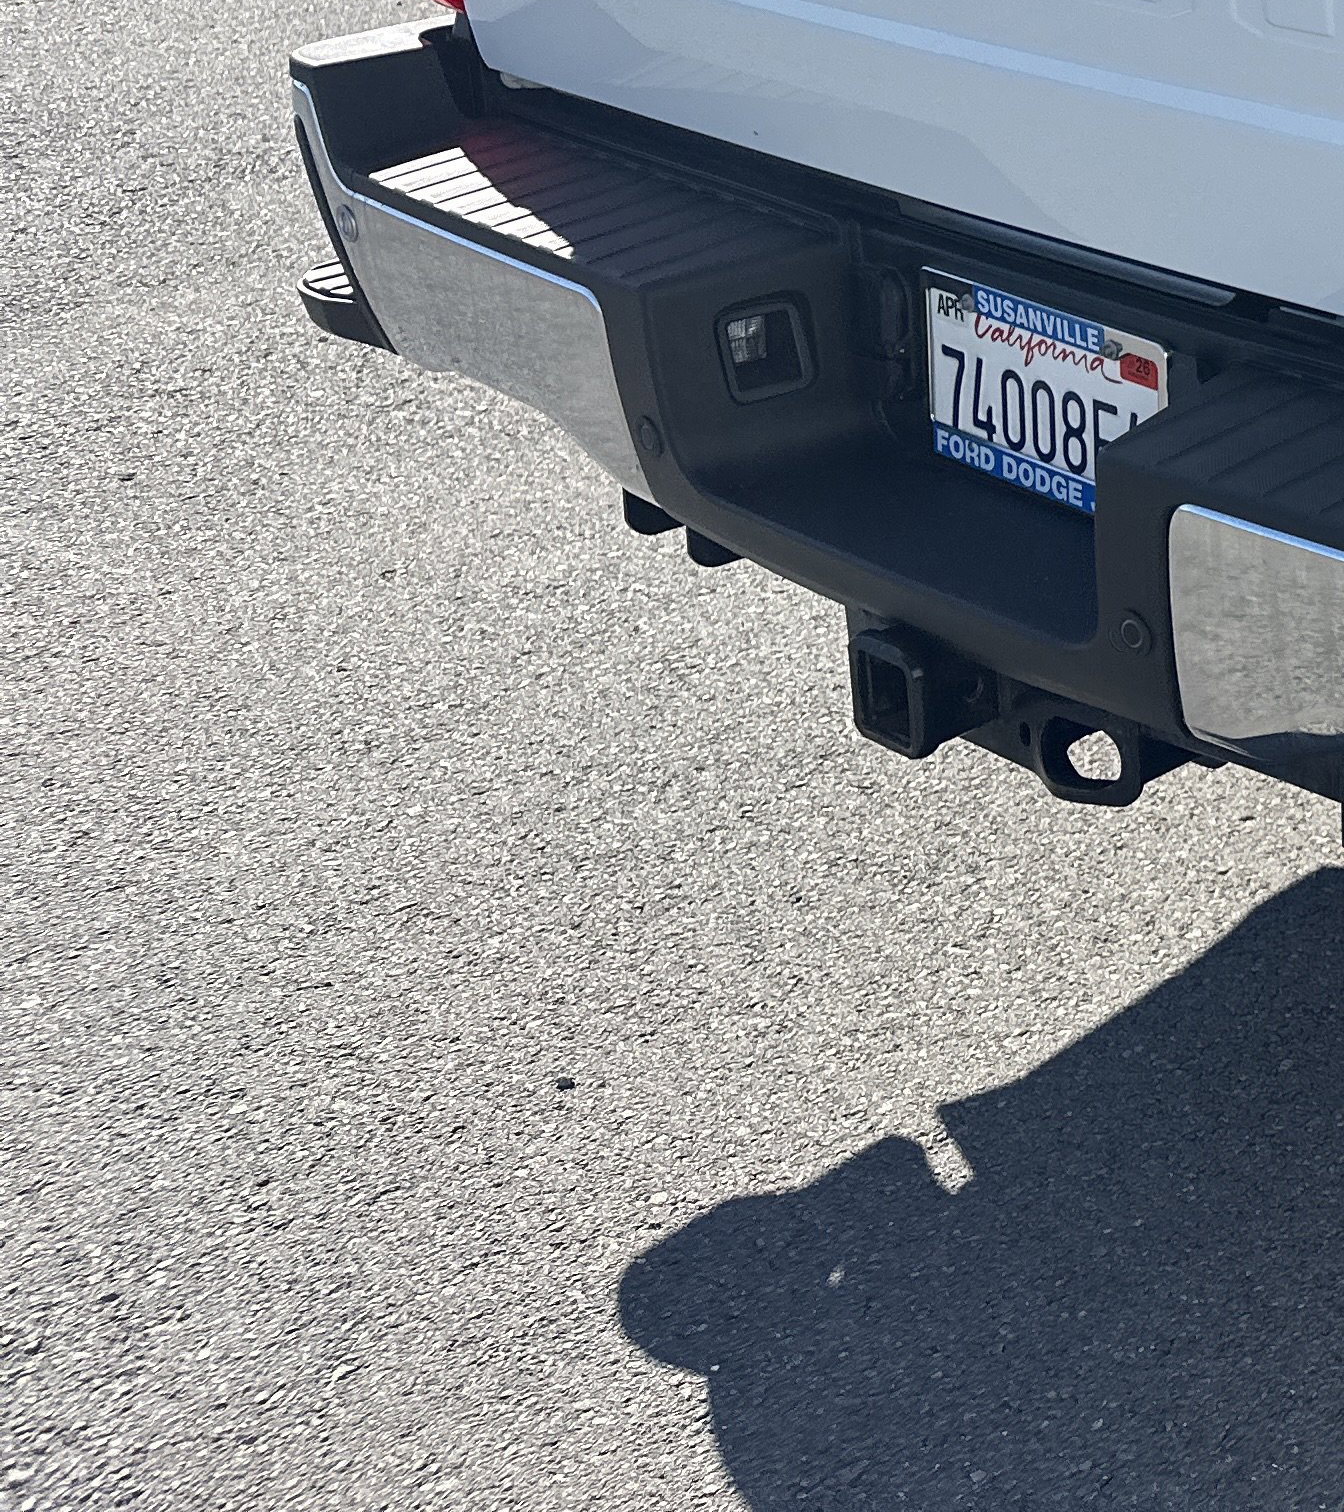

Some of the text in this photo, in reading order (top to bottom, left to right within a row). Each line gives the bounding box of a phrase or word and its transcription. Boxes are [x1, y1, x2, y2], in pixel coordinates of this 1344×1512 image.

[936, 293, 966, 324] APR
[975, 290, 1101, 353] SUSANVILLE
[974, 314, 1123, 385] California
[936, 427, 1083, 508] FORD DODGE
